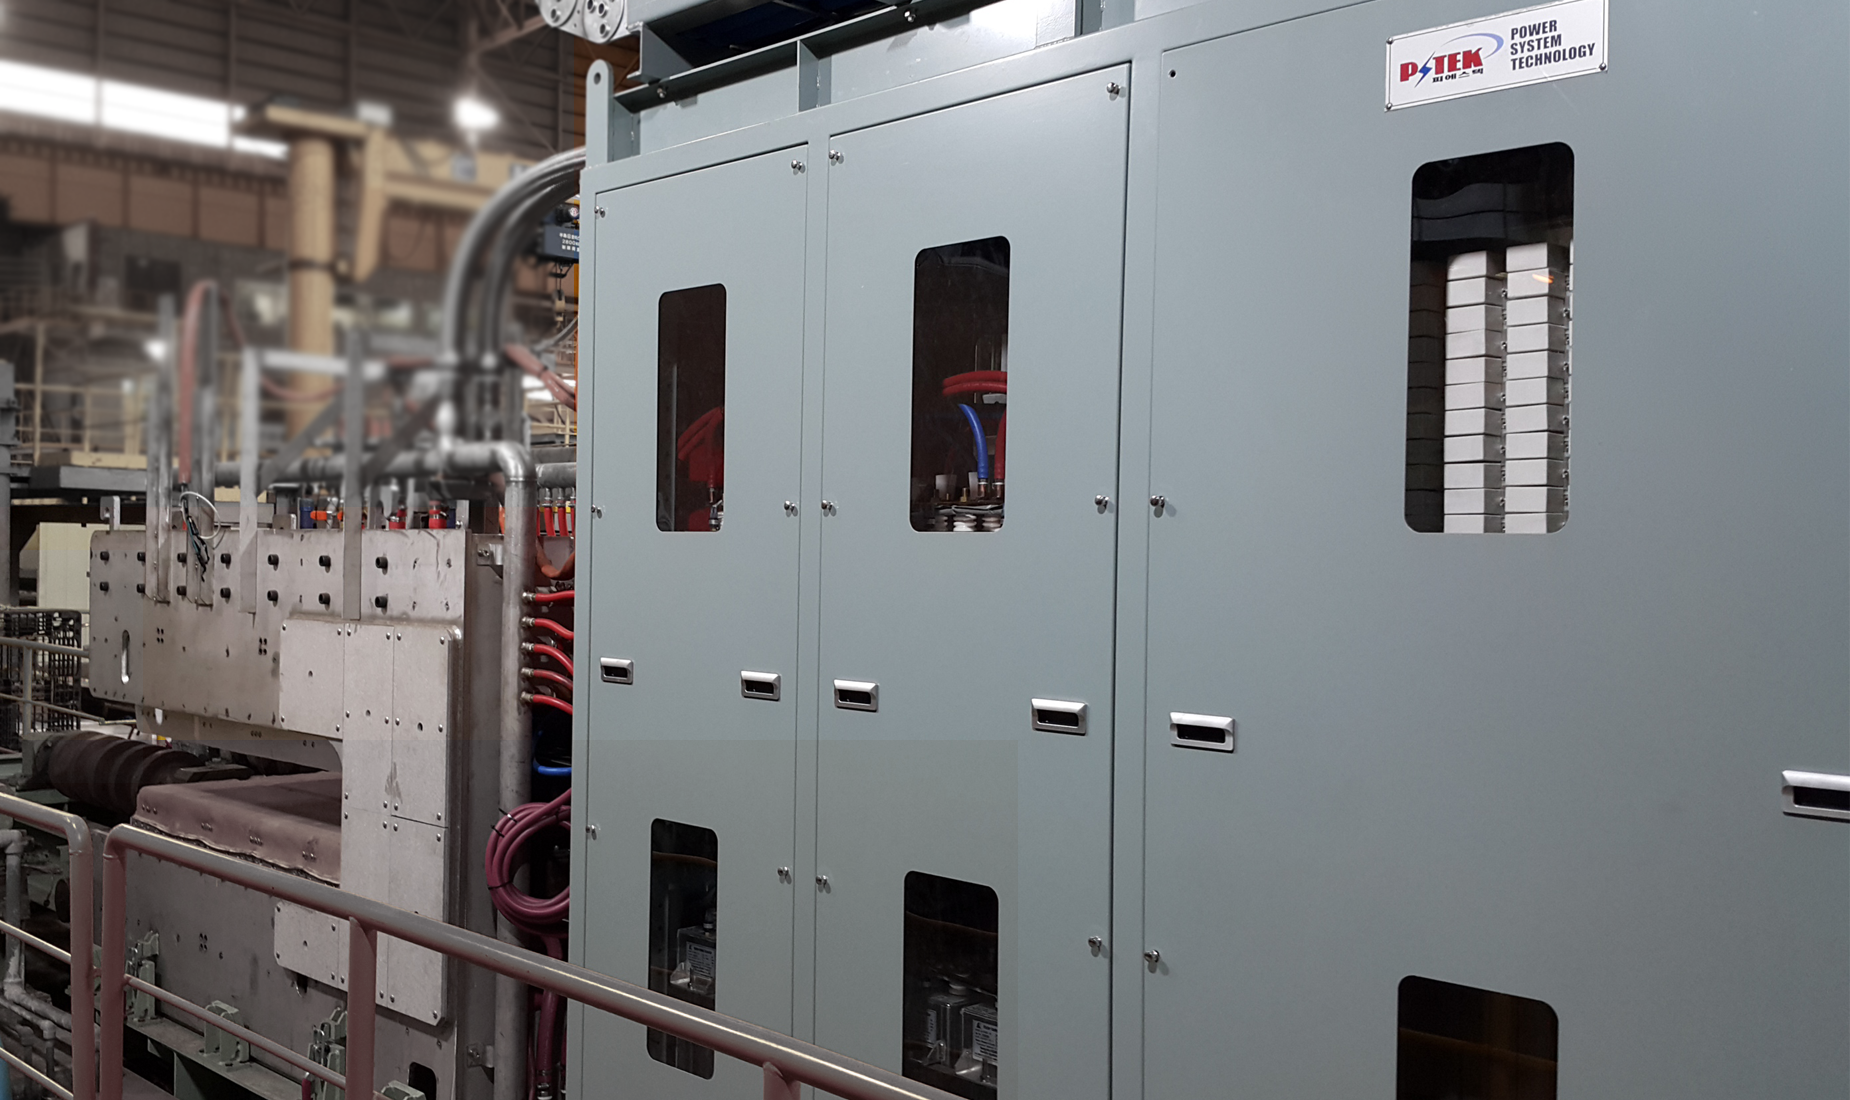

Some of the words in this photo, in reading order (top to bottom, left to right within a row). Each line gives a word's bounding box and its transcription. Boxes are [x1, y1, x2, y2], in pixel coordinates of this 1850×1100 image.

[1511, 19, 1558, 41] POWER
[1510, 33, 1562, 56] SYSTEM
[1510, 42, 1596, 71] TECHNOLOGY
